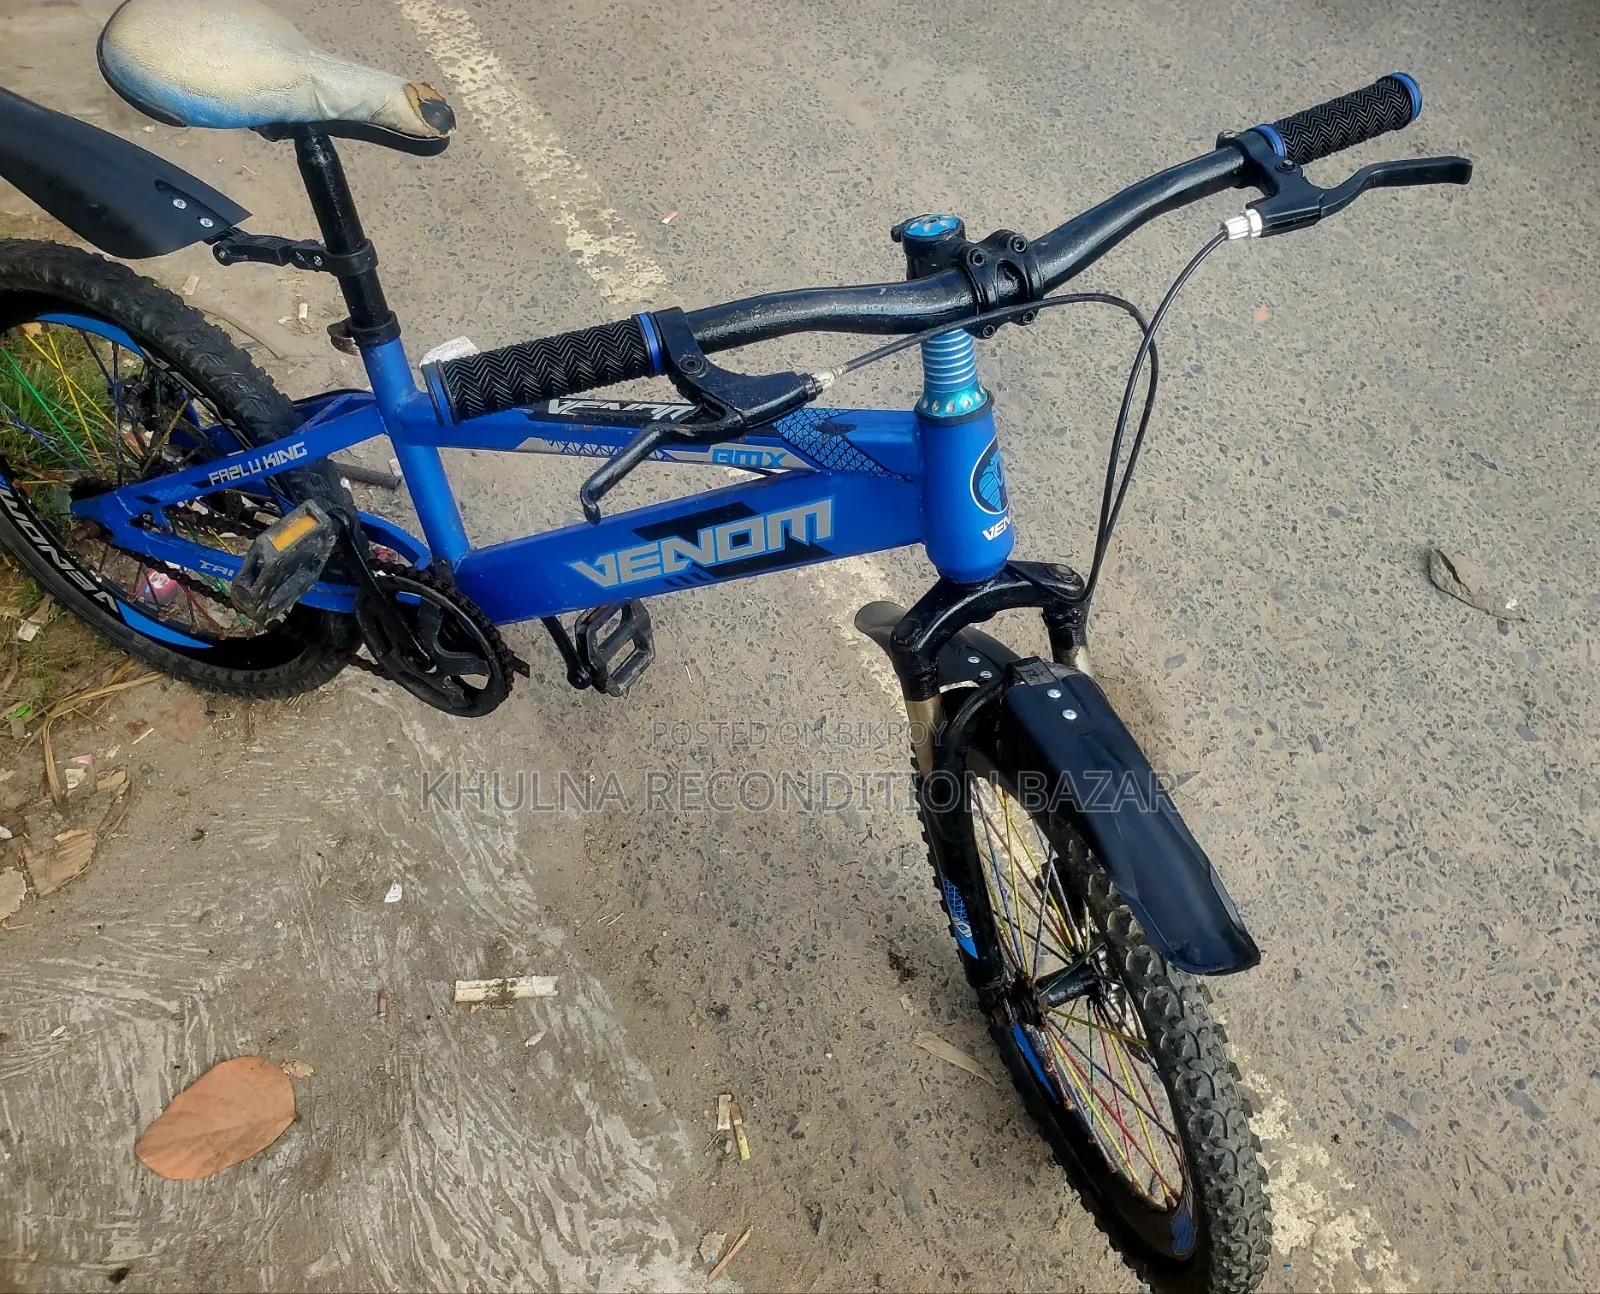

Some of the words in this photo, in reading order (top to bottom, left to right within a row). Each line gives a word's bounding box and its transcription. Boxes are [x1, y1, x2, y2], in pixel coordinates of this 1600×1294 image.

[262, 441, 308, 470] KING
[711, 447, 788, 468] BMX
[565, 496, 834, 590] VENOM
[982, 515, 1012, 542] VEN
[0, 488, 119, 614] VENOM
